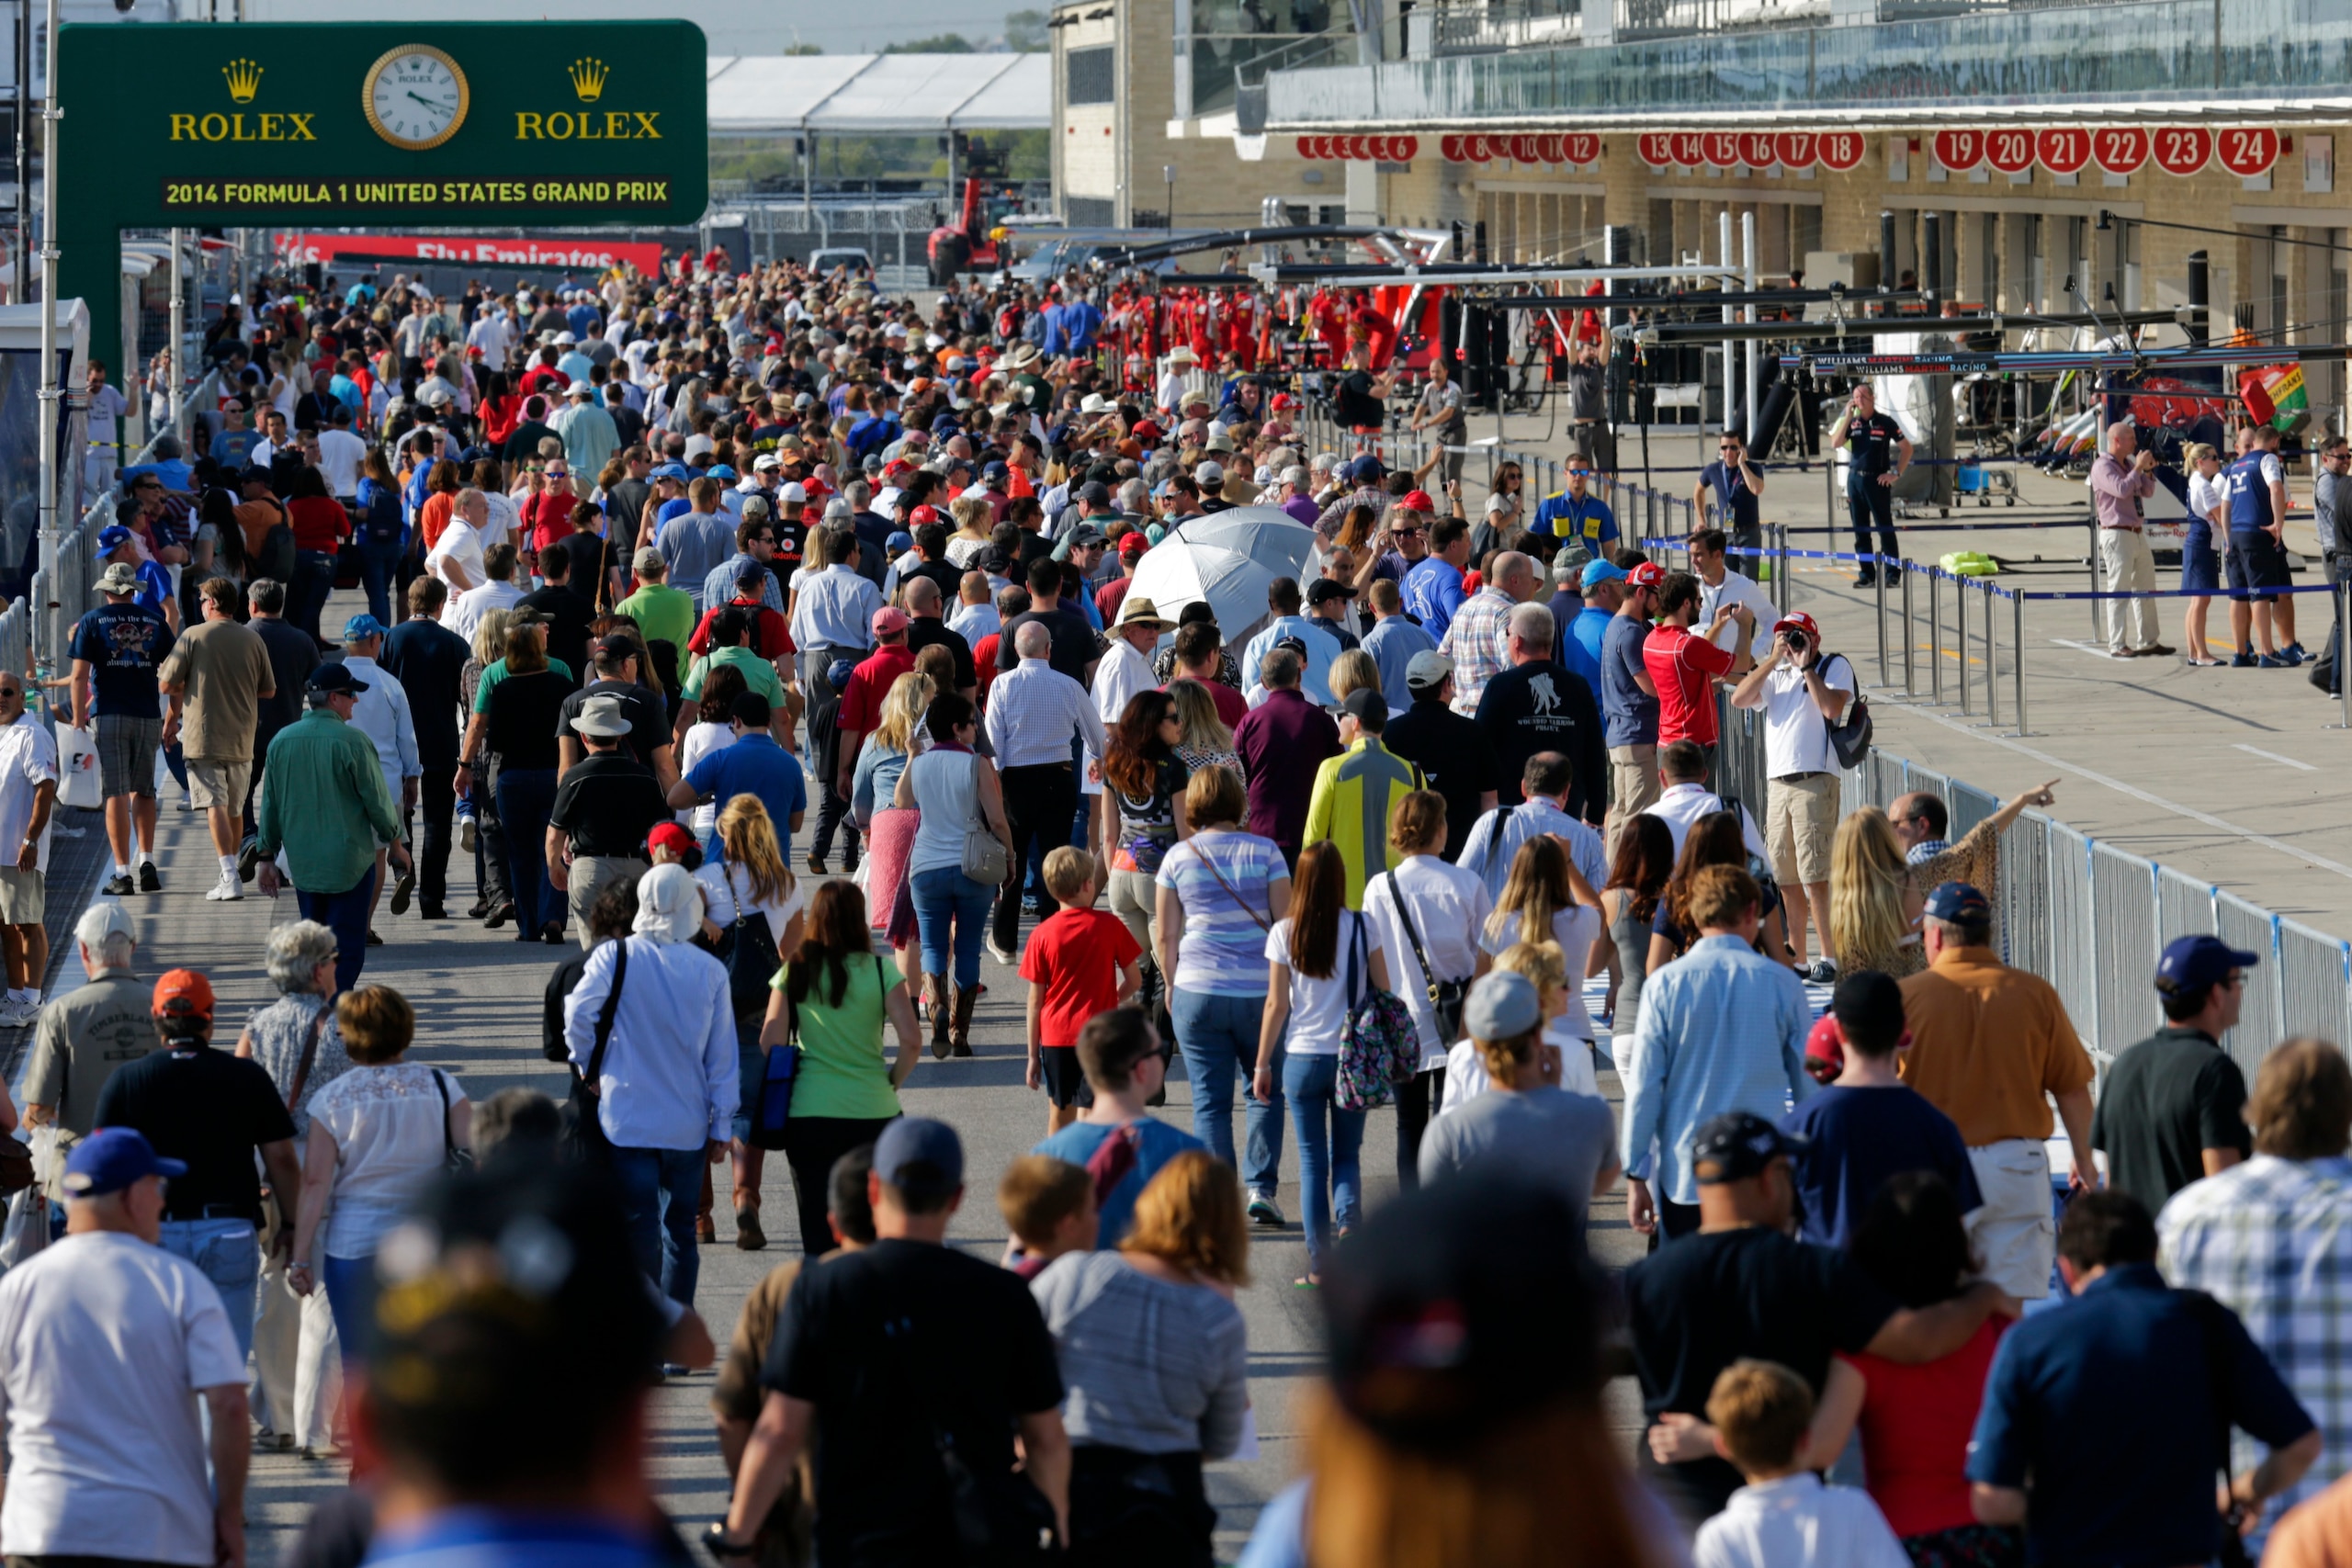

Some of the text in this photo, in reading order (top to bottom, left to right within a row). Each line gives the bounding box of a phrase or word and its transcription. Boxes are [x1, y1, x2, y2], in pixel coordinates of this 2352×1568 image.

[398, 75, 433, 84] ROLEX
[170, 113, 317, 141] ROLEX
[515, 111, 662, 141] ROLEX
[1359, 137, 1370, 156] 4
[1396, 138, 1408, 158] 6
[1453, 137, 1464, 157] 7
[1476, 137, 1486, 157] 8
[1520, 137, 1536, 158] 10
[1547, 137, 1562, 158] 11
[1573, 137, 1590, 158] 12
[1650, 135, 1668, 158] 13
[1681, 135, 1700, 159] 14
[1714, 135, 1735, 159] 15
[1750, 135, 1770, 160] 16
[1790, 135, 1810, 161] 17
[1830, 135, 1851, 162] 18
[1950, 133, 1973, 162] 19
[1997, 134, 2027, 164] 20
[2051, 133, 2075, 164] 21
[2106, 132, 2137, 164] 22
[2166, 132, 2199, 164] 23
[2233, 132, 2265, 164] 24
[166, 181, 668, 203] 2014 FORMULA 1 UNITED STATES GRAND PRIX
[475, 244, 613, 269] Emirates
[1817, 356, 1867, 365] WILLIAMS
[1867, 355, 1914, 364] MARTINI
[1856, 362, 1987, 375] WILLIAMS MARTINI RACING
[772, 551, 803, 560] odafon
